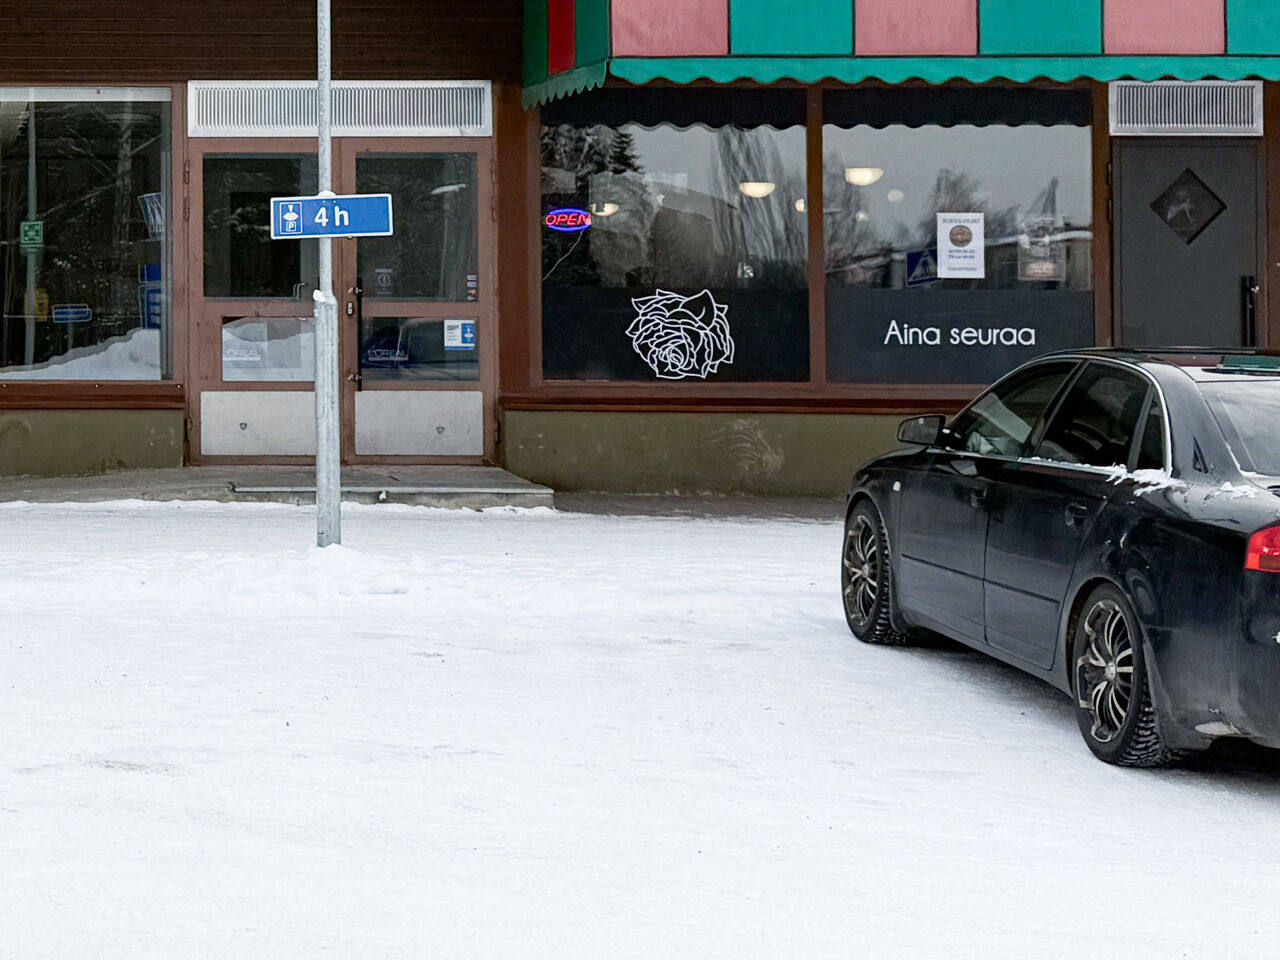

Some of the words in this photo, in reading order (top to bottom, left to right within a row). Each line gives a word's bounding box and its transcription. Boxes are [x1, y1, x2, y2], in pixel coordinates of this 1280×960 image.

[545, 213, 592, 226] OPEN
[884, 320, 940, 345] Aina
[950, 327, 1035, 345] seuraa
